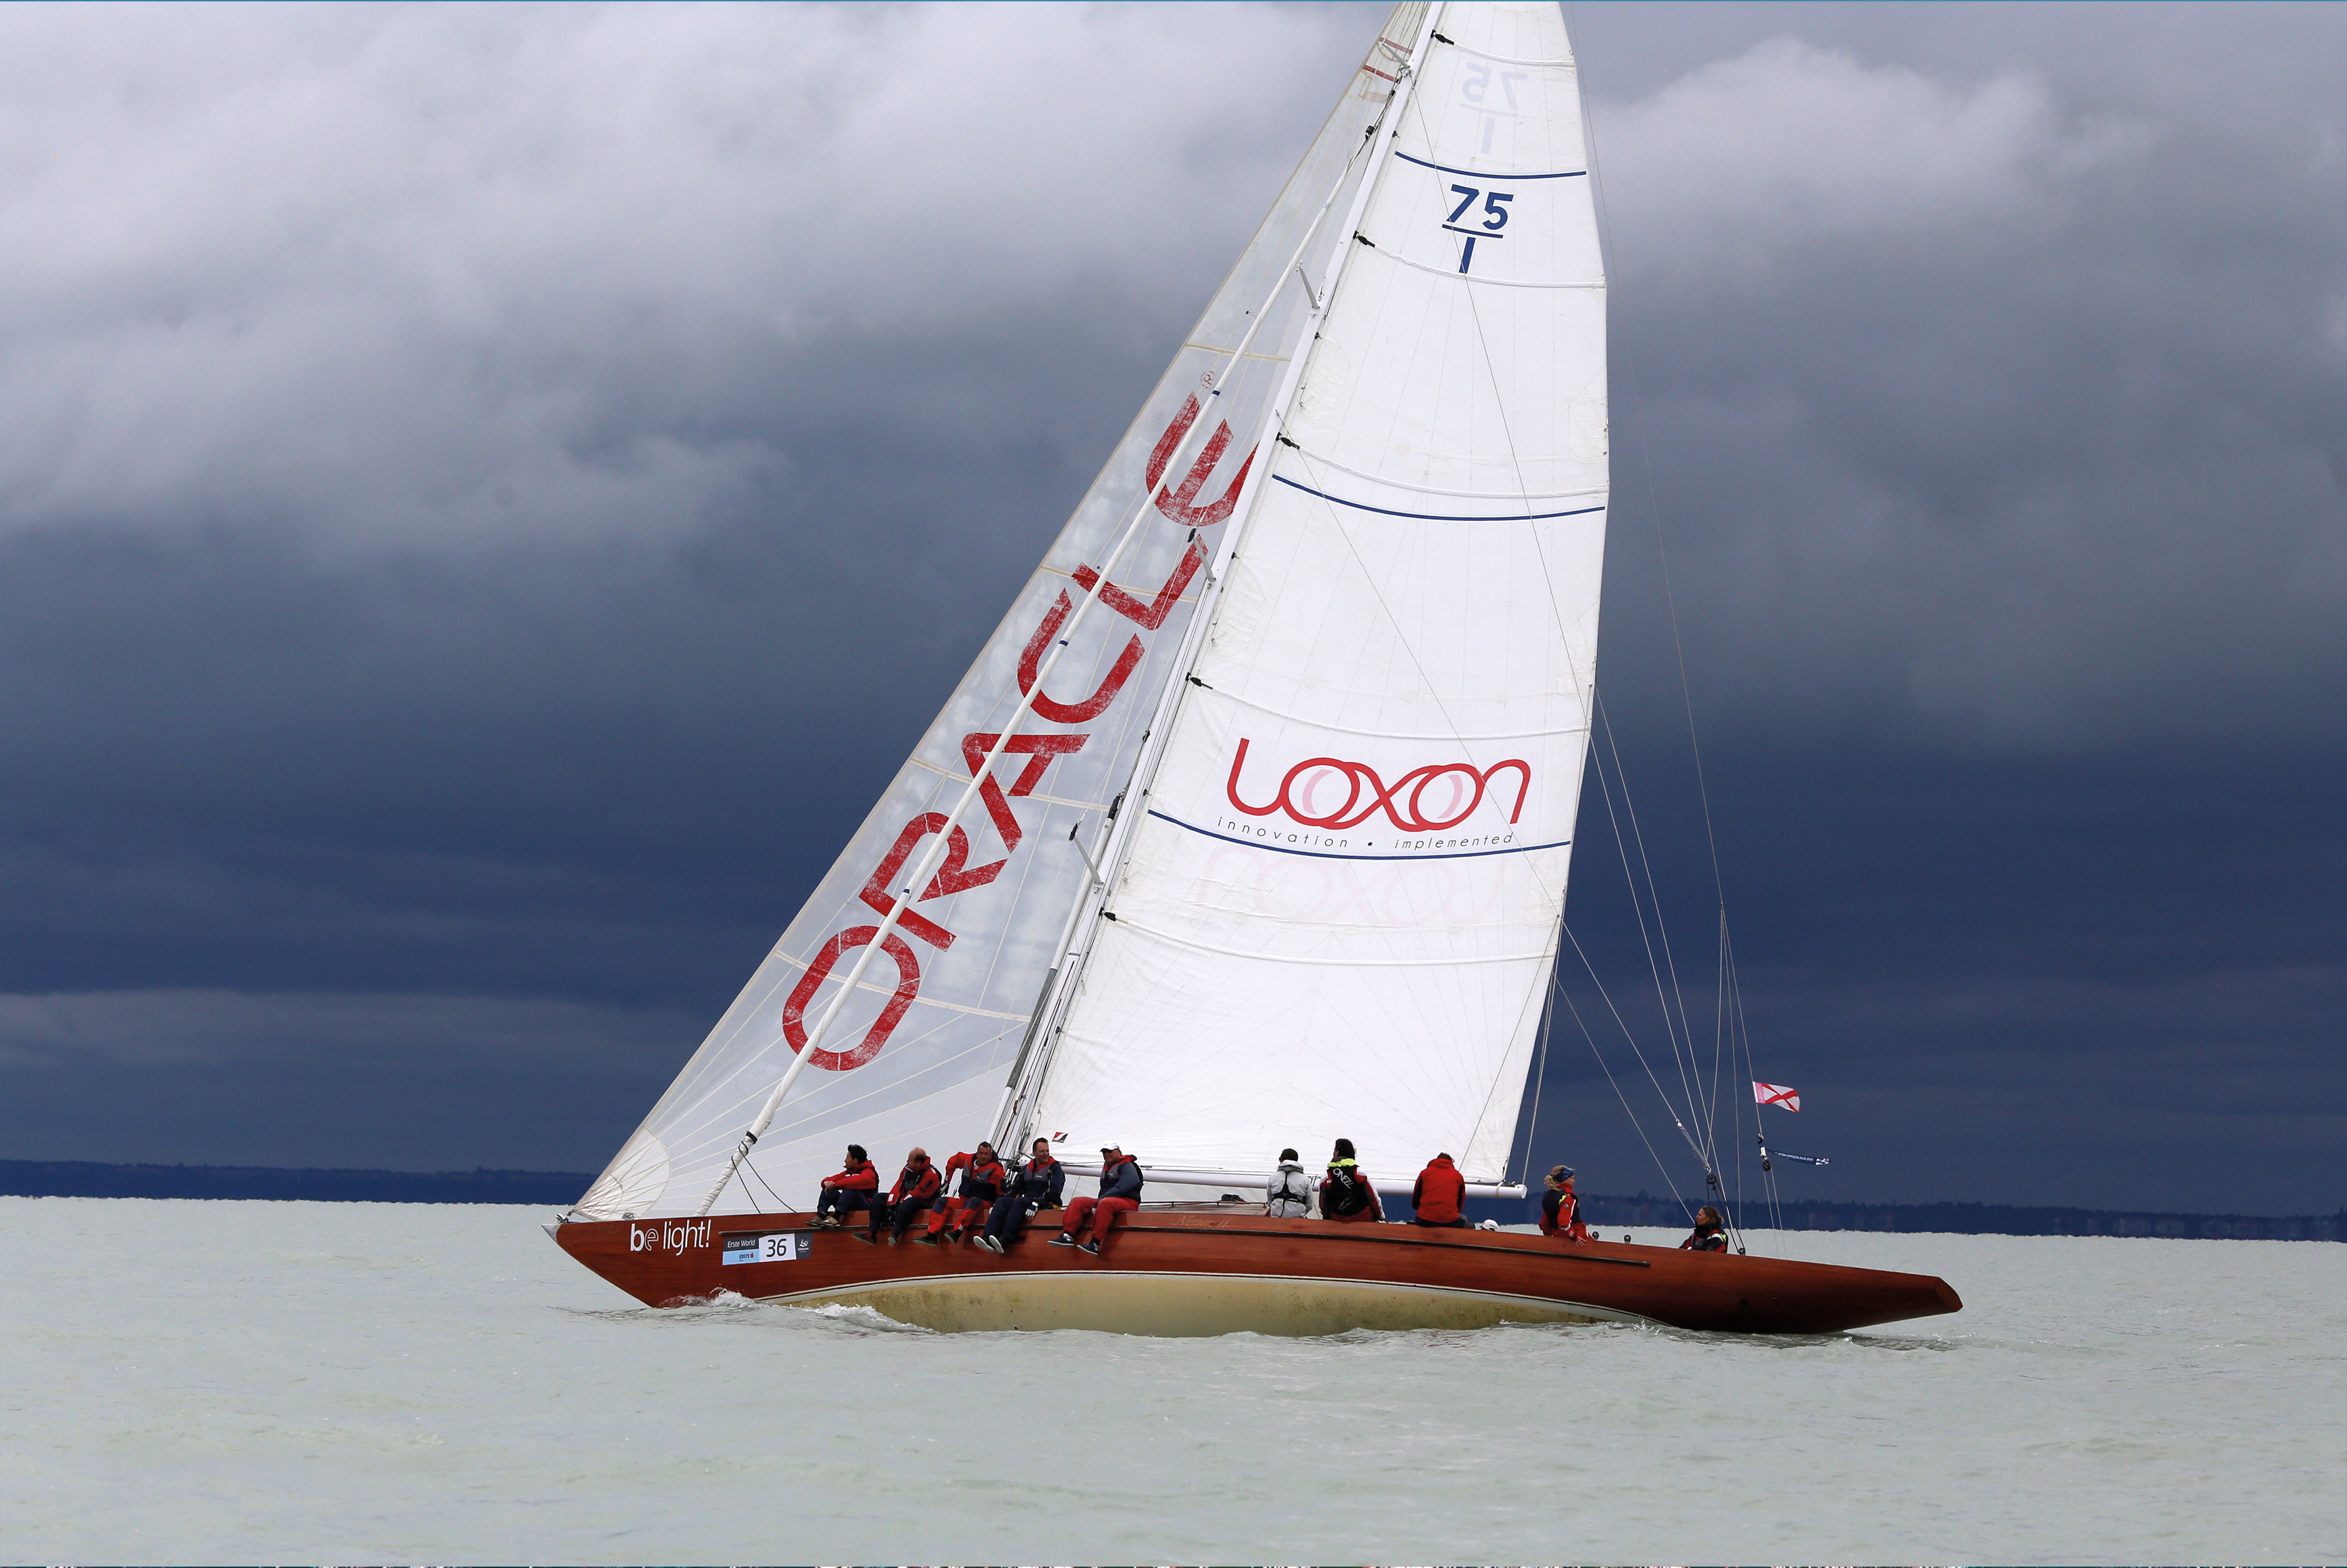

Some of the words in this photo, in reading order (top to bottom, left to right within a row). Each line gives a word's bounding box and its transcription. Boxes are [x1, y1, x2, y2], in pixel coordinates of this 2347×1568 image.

[1446, 184, 1514, 231] 75
[782, 390, 1258, 1072] ORACLE
[1218, 816, 1348, 848] innovation
[1394, 831, 1514, 851] implemented
[630, 1223, 659, 1251] be
[663, 1219, 712, 1256] light!
[740, 1239, 756, 1247] World
[766, 1238, 787, 1258] 36
